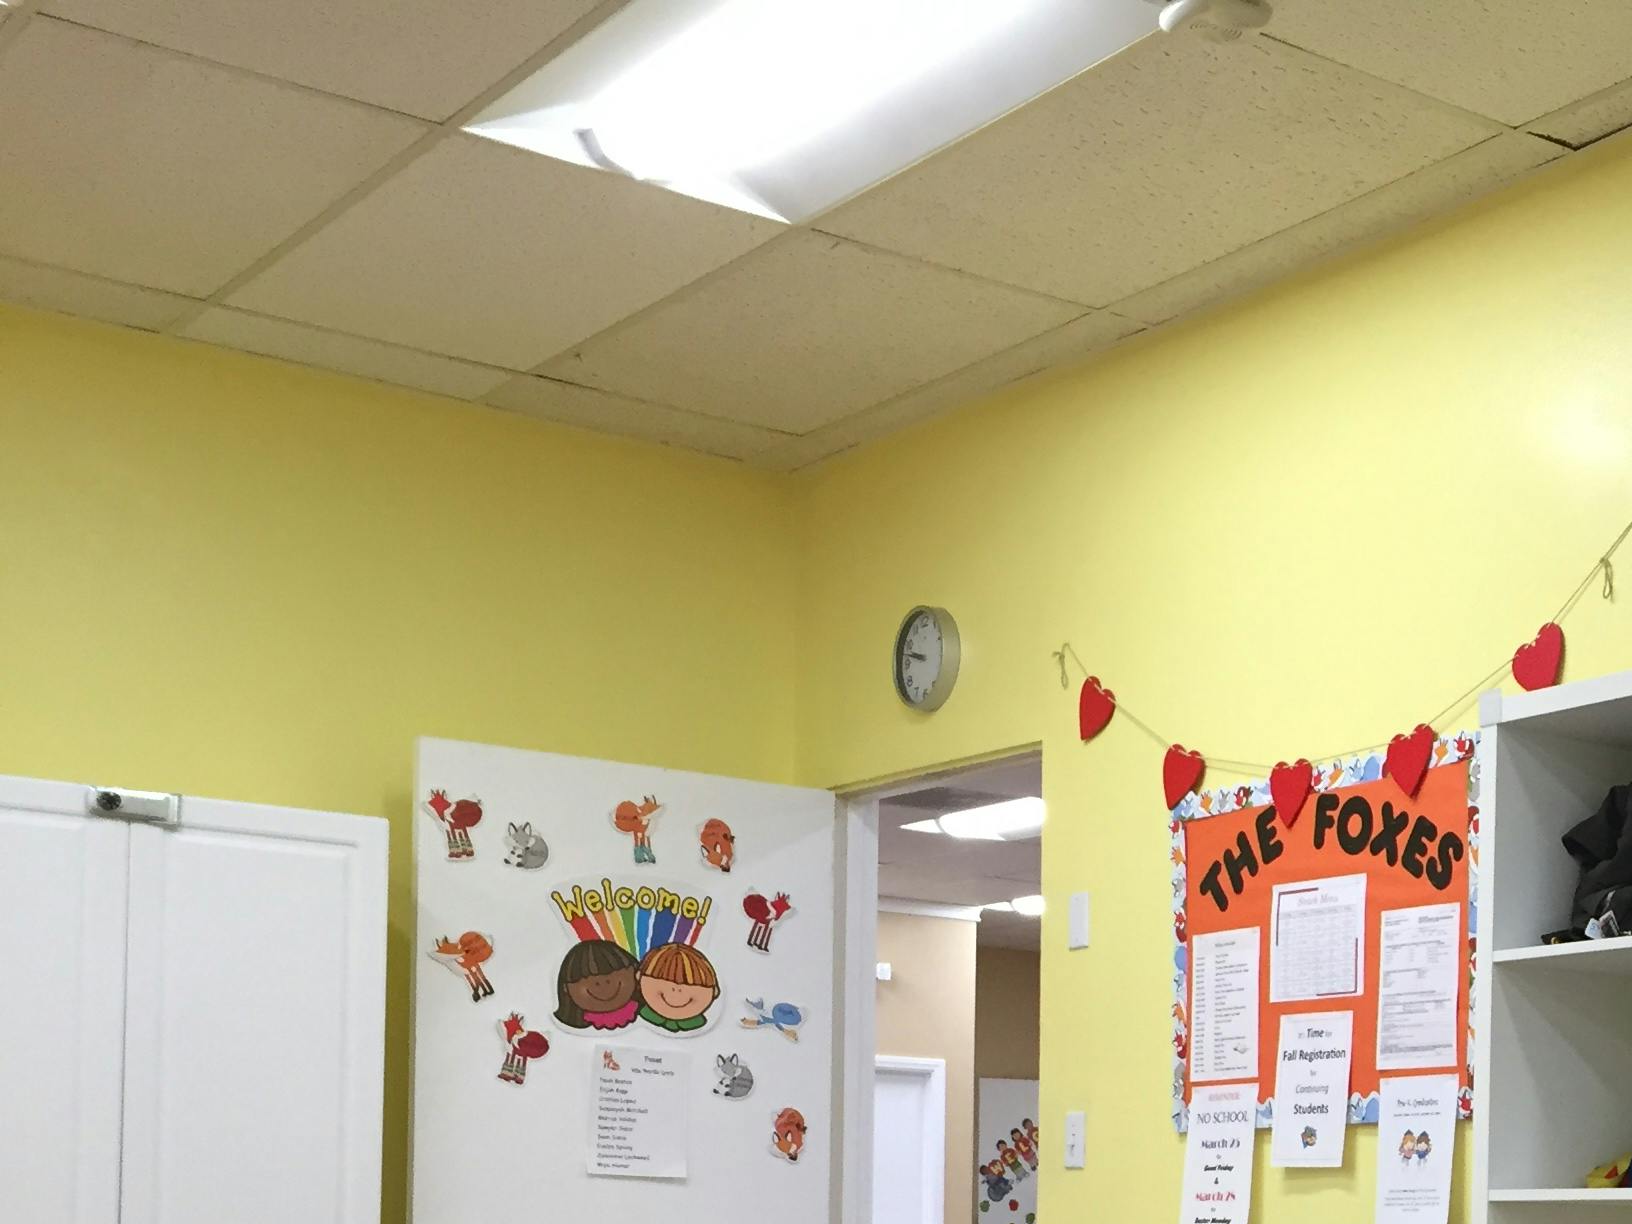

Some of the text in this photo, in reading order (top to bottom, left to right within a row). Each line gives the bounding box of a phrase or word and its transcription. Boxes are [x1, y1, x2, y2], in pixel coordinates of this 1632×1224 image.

[1199, 793, 1464, 912] THE FOXES
[551, 878, 713, 926] Welcome!
[1307, 1027, 1324, 1039] Time
[1283, 1047, 1347, 1063] Fall Registration
[1293, 1103, 1329, 1115] Students
[1197, 1110, 1248, 1124] NO SCHOOL
[1201, 1138, 1228, 1149] March
[1195, 1191, 1223, 1201] March
